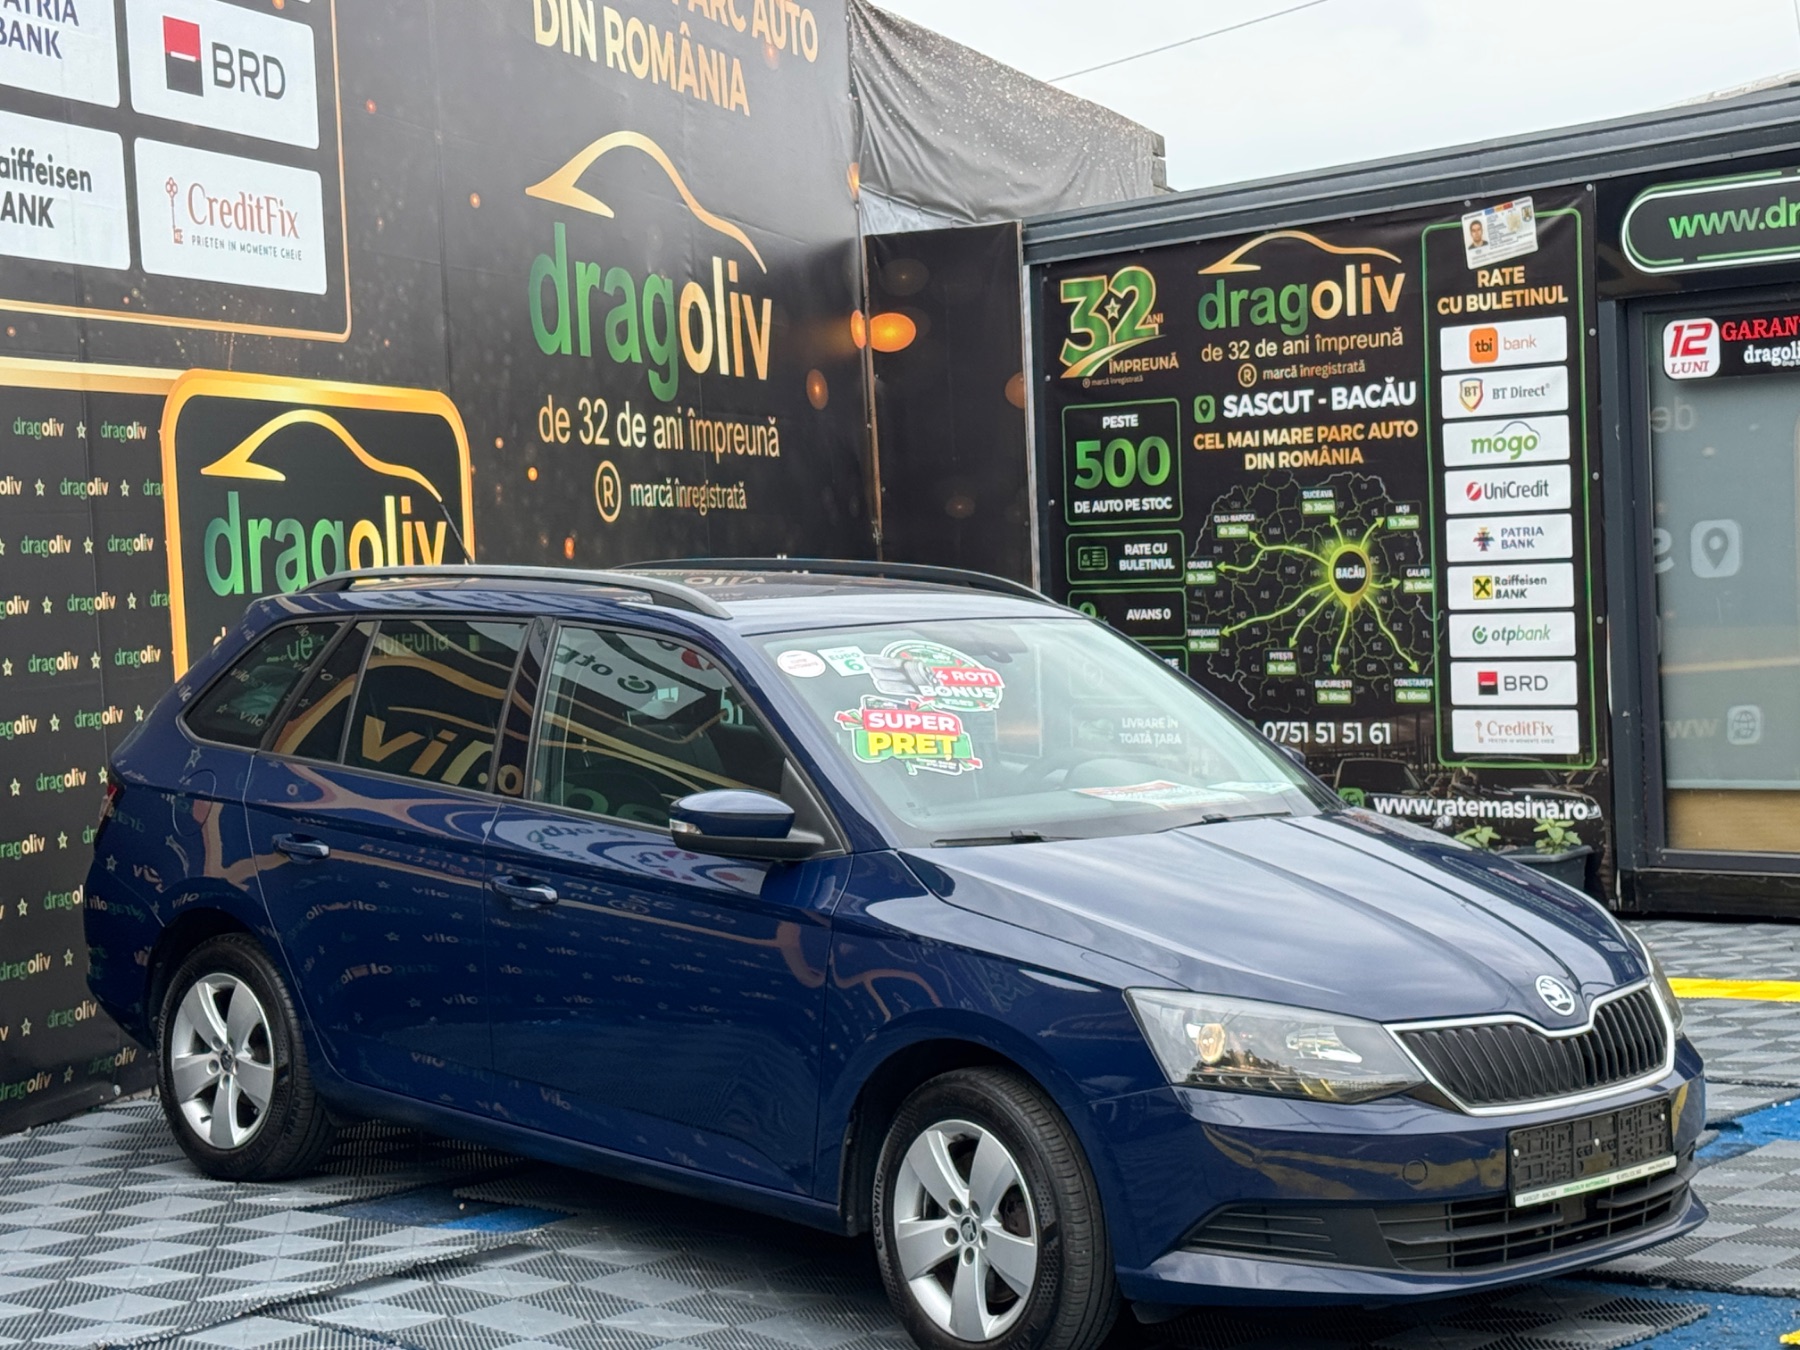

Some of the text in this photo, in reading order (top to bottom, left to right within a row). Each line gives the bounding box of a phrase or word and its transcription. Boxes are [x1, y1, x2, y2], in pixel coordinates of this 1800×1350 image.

[752, 0, 819, 63] AUTO
[534, 0, 750, 117] DIN ROMÂNIA
[212, 41, 286, 100] BRD
[188, 182, 301, 239] CreditFix
[1477, 265, 1526, 288] RATE
[1198, 262, 1406, 336] dragoliv
[1437, 285, 1569, 315] CU BULETINUL
[529, 222, 772, 402] dragoliv
[1059, 265, 1157, 367] 32
[1669, 322, 1712, 358] 12
[1721, 315, 1800, 342] GARAN
[1201, 326, 1404, 363] de 32 de ani împreună
[1475, 335, 1537, 353] tbi bank
[1263, 364, 1298, 380] marcă
[1300, 359, 1366, 379] înregistrată
[1671, 360, 1710, 375] LUNI
[1222, 388, 1314, 419] SASCUT
[1331, 376, 1417, 412] BACĂU
[1464, 385, 1479, 398] BT
[1492, 387, 1507, 400] BT
[13, 417, 64, 440] dragoliv
[100, 421, 147, 443] dragoliv
[538, 394, 781, 465] de 32 de ani împreună
[1102, 414, 1139, 429] PESTE
[1193, 419, 1419, 451] CEL MAI MARE PARC AUTO
[1245, 445, 1364, 470] DIN ROMÂNIA
[1471, 434, 1538, 460] mogo
[1074, 435, 1171, 490] 500
[60, 477, 109, 500] dragoliv
[630, 477, 674, 508] marcă
[675, 477, 748, 516] înregistrată
[1484, 479, 1549, 500] UniCredit
[1074, 496, 1173, 514] DE AUTO PE STOC
[204, 490, 447, 597] dragoliv
[1501, 526, 1544, 538] PATRIA
[21, 534, 71, 559] dragoliv
[107, 533, 154, 556] dragoliv
[1124, 542, 1168, 556] RATE CU
[1501, 538, 1535, 550] BANK
[1119, 558, 1175, 571] BULETINUL
[1335, 564, 1366, 580] BACĂU
[1494, 573, 1547, 586] Raiffeisen
[67, 591, 116, 615] dragoliv
[1495, 588, 1528, 600] BANK
[1126, 608, 1162, 621] AVANS
[1491, 623, 1551, 646] otpbank
[28, 651, 79, 676] dragoliv
[114, 645, 161, 668] dragoliv
[844, 658, 865, 672] 6
[918, 684, 998, 699] BONUS
[1504, 675, 1549, 691] BRD
[74, 705, 124, 730] dragoliv
[868, 712, 956, 732] SUPER
[1121, 717, 1166, 730] LIVRARE
[1486, 720, 1554, 737] CreditFix
[1119, 730, 1152, 745] TOATĂ
[1262, 721, 1391, 745] 0751 51 51 61
[868, 731, 958, 761] PREȚ
[36, 767, 87, 793] dragoliv
[1373, 794, 1588, 821] www.ratemasina.ro
[47, 1000, 98, 1029] dragoliv
